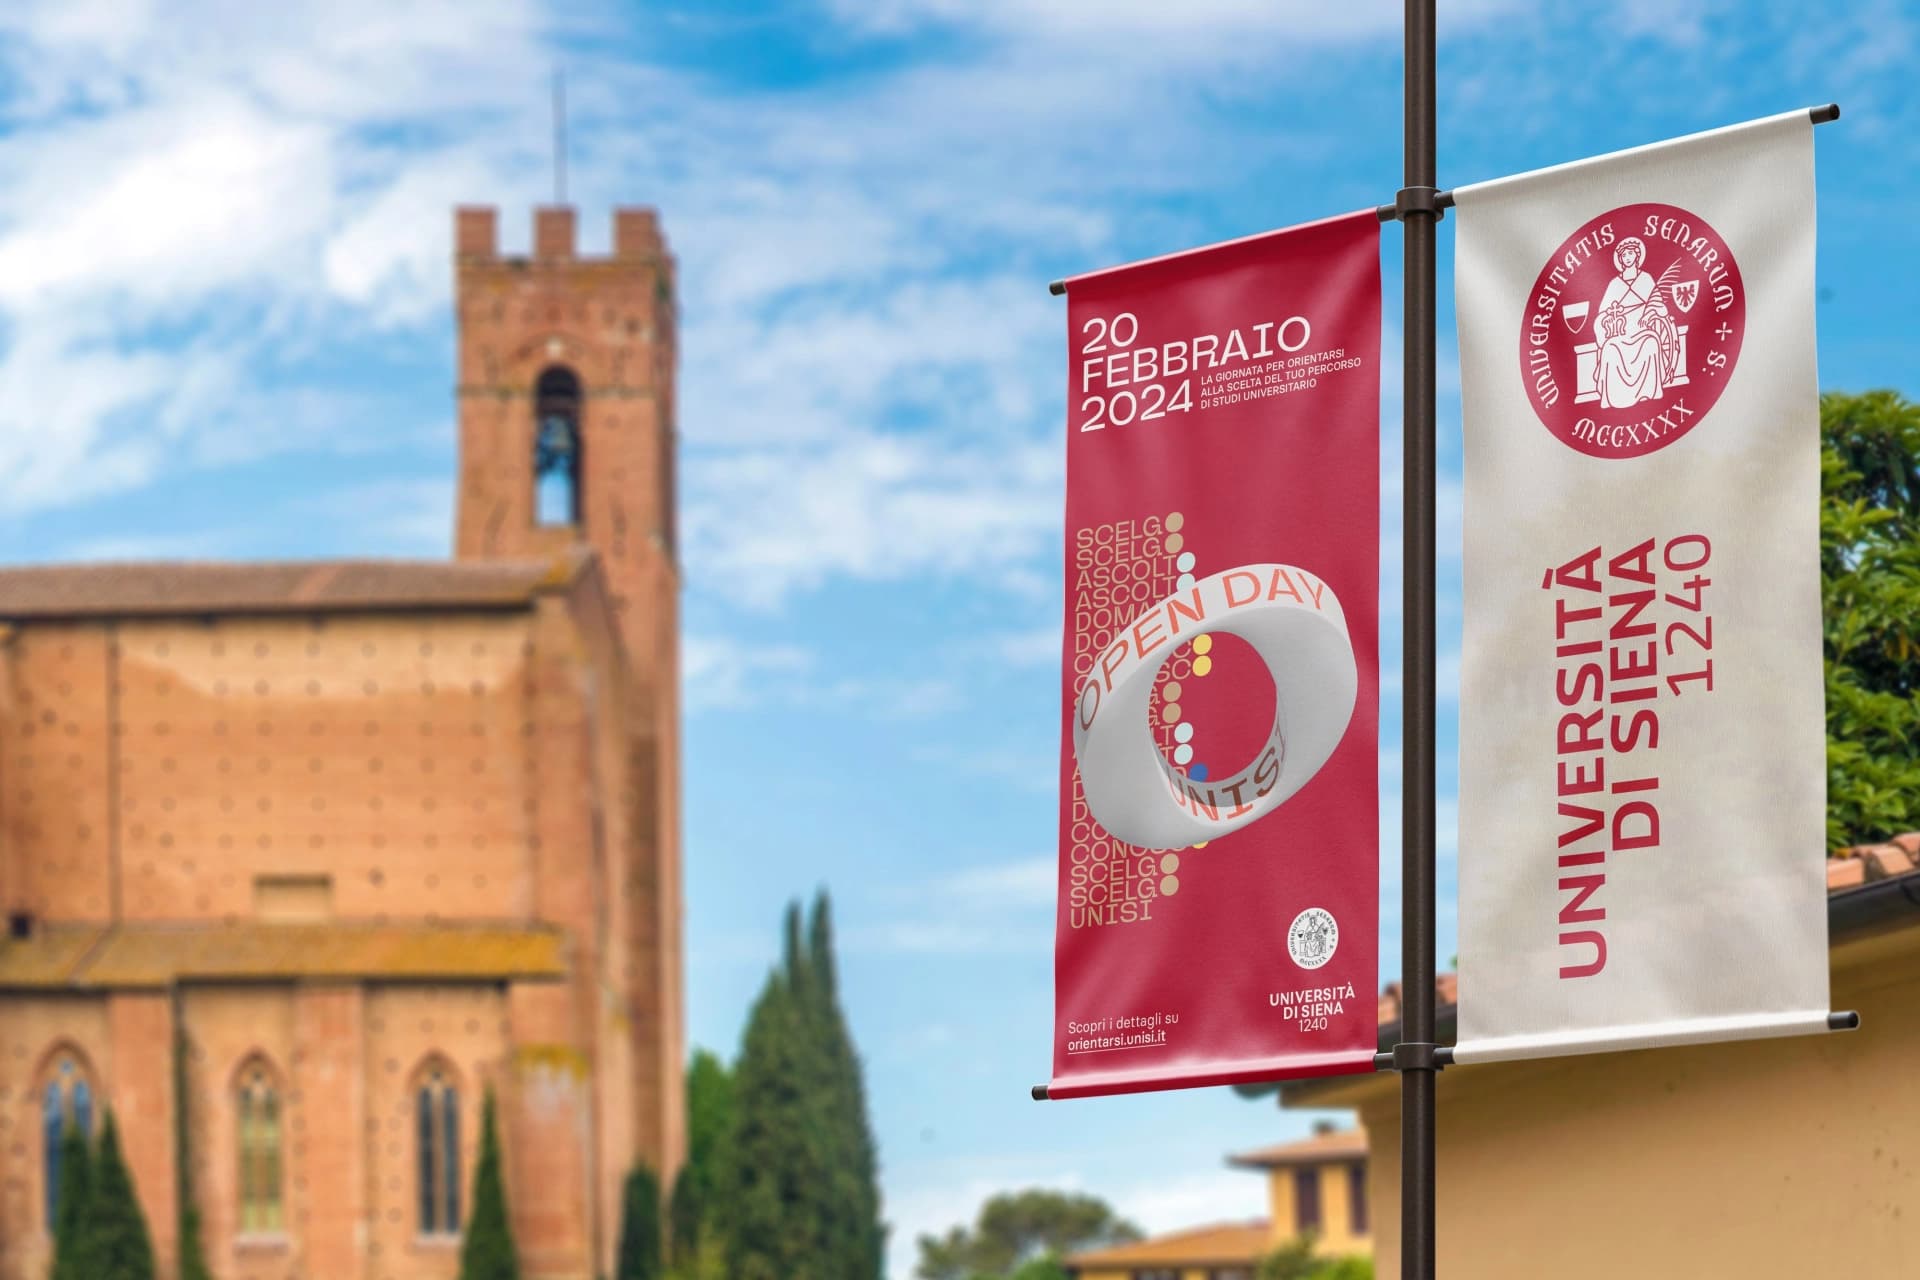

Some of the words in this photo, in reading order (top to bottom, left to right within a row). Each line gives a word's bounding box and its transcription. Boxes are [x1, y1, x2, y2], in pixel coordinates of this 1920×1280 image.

[1081, 311, 1139, 355] 20
[1081, 315, 1312, 394] FEBBRAIO
[1201, 375, 1213, 386] LA
[1215, 366, 1264, 383] GIORNATA
[1266, 360, 1285, 373] PER
[1287, 348, 1345, 369] ORIENTARSI
[1200, 384, 1225, 398] ALLA
[1226, 376, 1262, 393] SCELTA
[1264, 373, 1283, 385] DEL
[1285, 368, 1306, 381] TUO
[1308, 356, 1362, 377] PERCORSO
[1200, 399, 1210, 409] DI
[1212, 393, 1241, 407] STUDI
[1243, 378, 1317, 401] UNIVERSITARIO
[1080, 379, 1194, 433] 2024
[1663, 533, 1714, 697] 1240
[1080, 586, 1206, 732] OPEN
[1221, 568, 1324, 610] DAY
[1609, 536, 1660, 754] SIENA
[1542, 545, 1608, 980] UNIVERSITÀ
[1611, 776, 1661, 852] DI
[1070, 900, 1153, 929] UNISI
[1269, 981, 1355, 1006] UNIVERSITÀ
[1283, 1005, 1298, 1020] DI
[1301, 1001, 1344, 1018] SIENA
[1067, 1029, 1167, 1051] orientarsi.unisi.it
[1068, 1018, 1106, 1035] Scopri
[1116, 1012, 1162, 1033] dettagli
[1164, 1013, 1179, 1025] su
[1299, 1017, 1328, 1033] 1240
